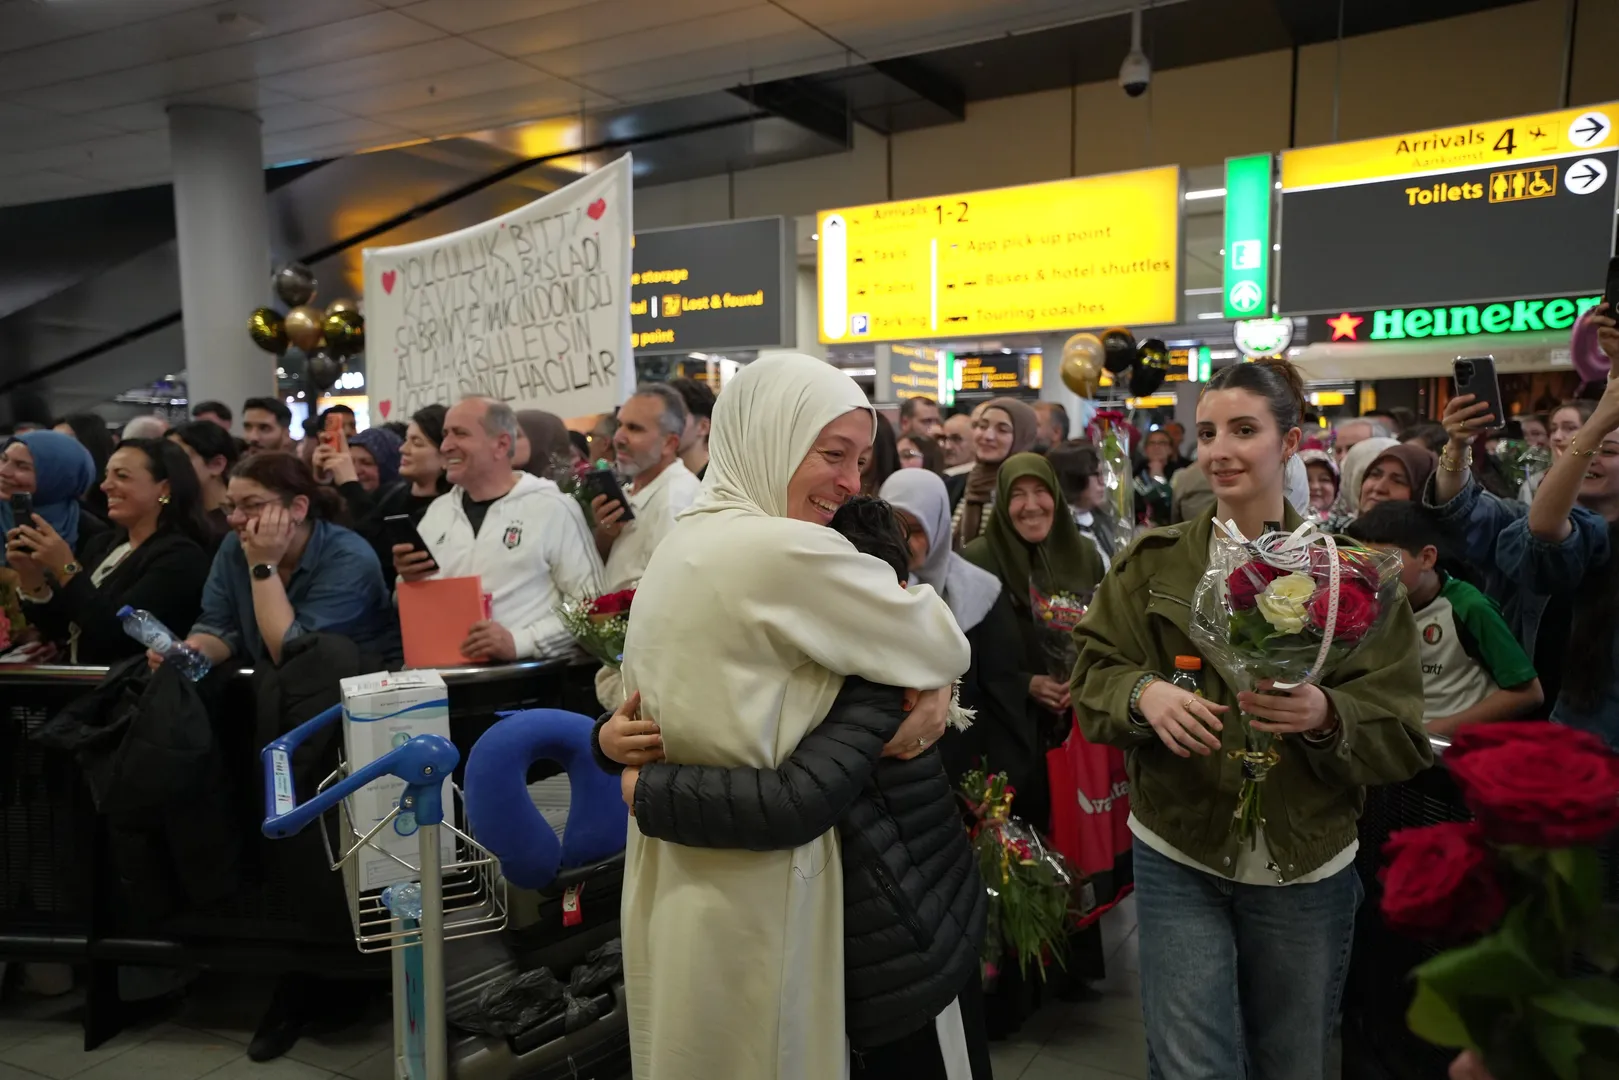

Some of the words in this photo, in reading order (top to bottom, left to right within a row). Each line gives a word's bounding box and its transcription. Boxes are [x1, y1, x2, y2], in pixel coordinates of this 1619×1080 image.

[1396, 128, 1485, 155] Arrivals
[1493, 128, 1517, 155] 4
[1405, 181, 1483, 206] Toilets
[873, 204, 928, 220] Arrivals
[935, 201, 969, 225] 1-2
[1067, 226, 1112, 243] point
[641, 268, 689, 285] storage
[1036, 269, 1046, 281] &
[1052, 264, 1095, 280] hotel
[1101, 257, 1172, 275] shuttles
[682, 296, 709, 311] Lost
[710, 294, 722, 309] &
[723, 289, 764, 308] found
[1041, 301, 1105, 318] coaches
[640, 328, 675, 347] point
